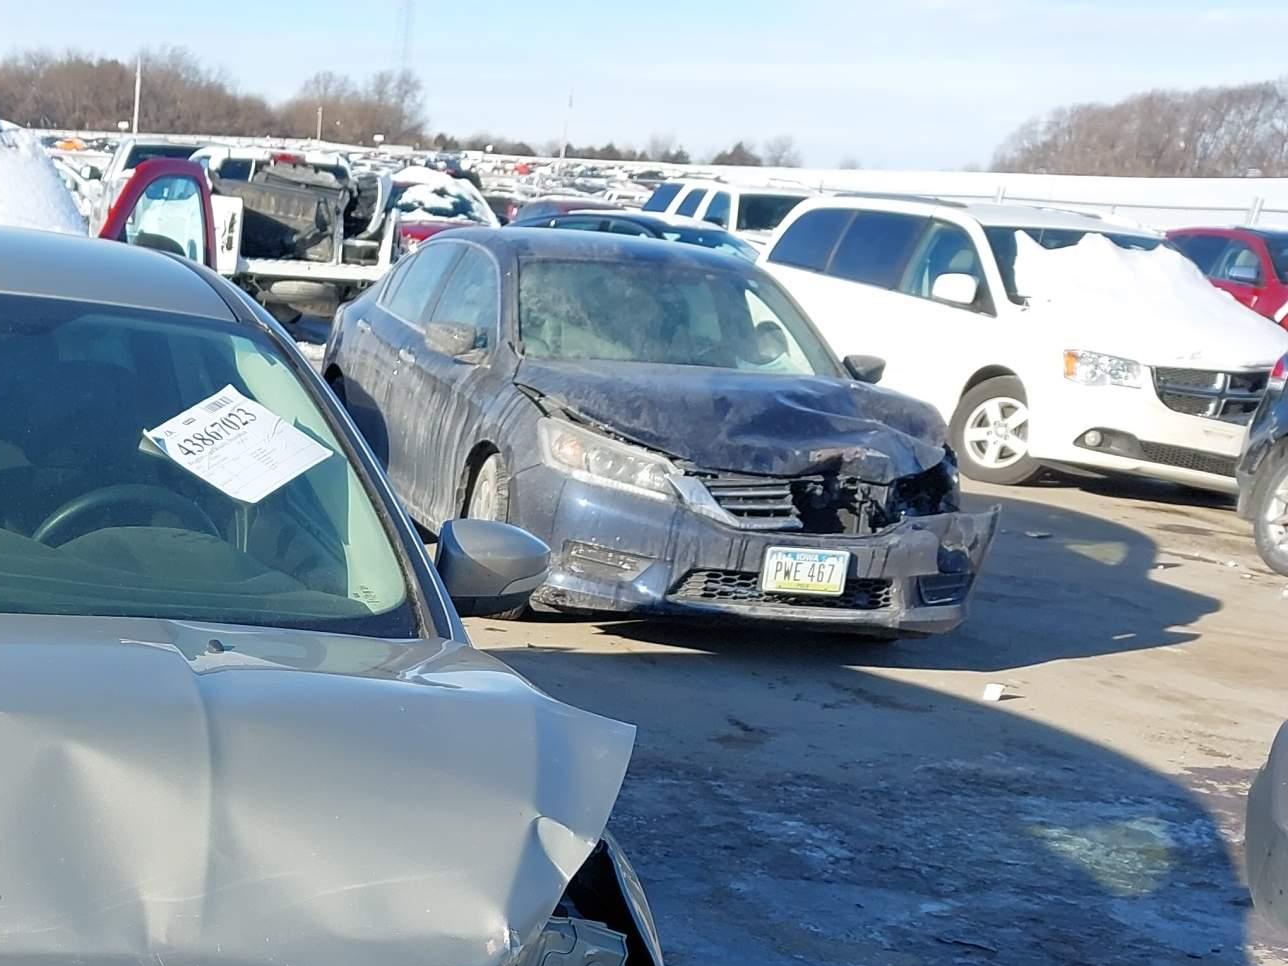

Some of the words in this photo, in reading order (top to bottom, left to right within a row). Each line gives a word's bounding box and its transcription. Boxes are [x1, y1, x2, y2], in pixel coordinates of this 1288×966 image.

[177, 408, 257, 457] 43867023
[774, 560, 803, 582] PWE
[808, 563, 835, 583] 467
